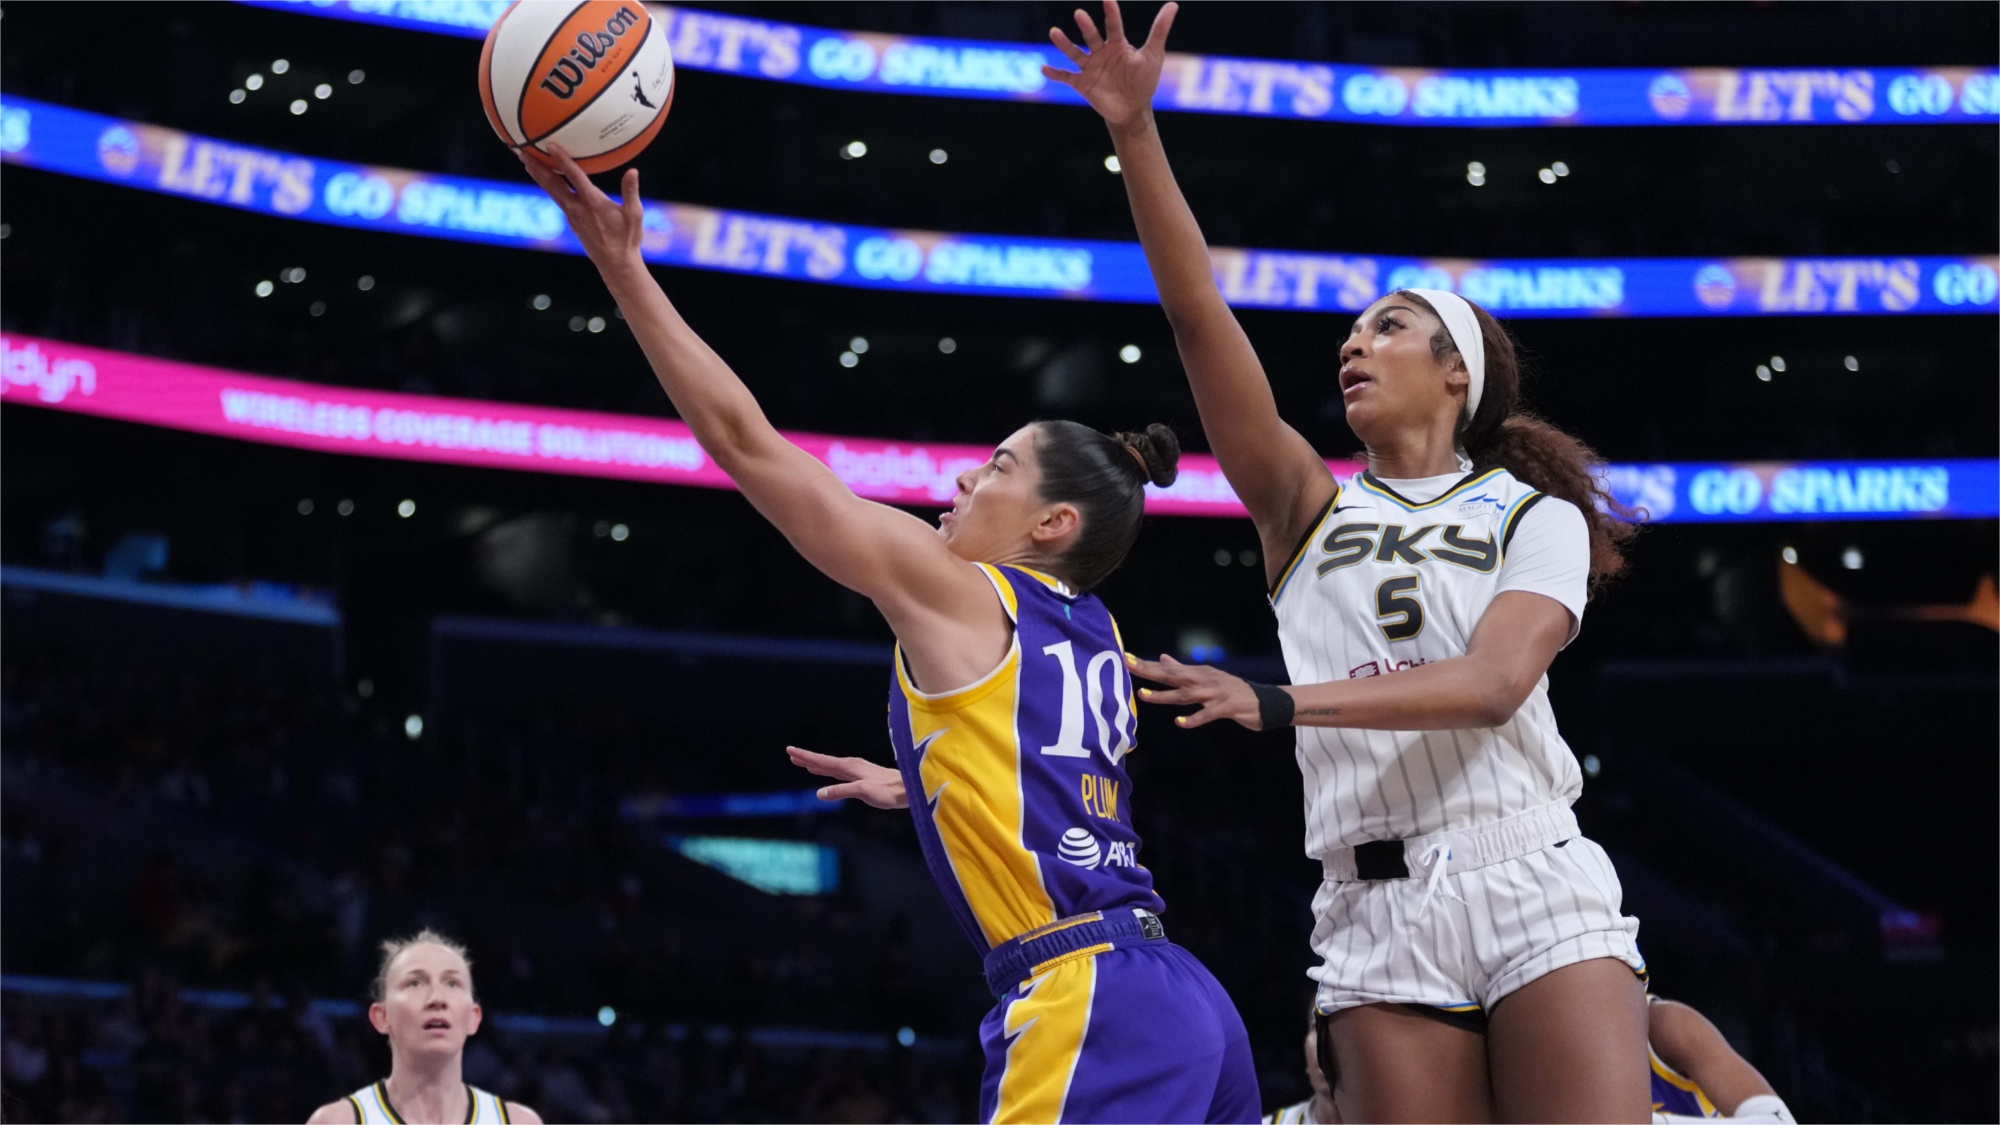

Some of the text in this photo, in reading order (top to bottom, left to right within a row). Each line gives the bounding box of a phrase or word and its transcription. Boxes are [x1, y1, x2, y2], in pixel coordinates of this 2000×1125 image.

[538, 5, 640, 101] Wilson
[808, 37, 877, 82] GO
[879, 43, 1047, 93] SPARKS
[1174, 55, 1580, 118] LET'S GO SPARKS
[1715, 71, 1875, 121] LET'S
[1887, 74, 1953, 115] GO
[158, 134, 566, 241] LET'S GO SPARKS
[692, 210, 1093, 291] LET'S GO SPARKS
[1222, 250, 1378, 311] LET'S
[1457, 266, 1624, 309] SPARKS
[1760, 258, 1998, 312] LET'S GO
[220, 387, 705, 472] WIRELESS COVERAGE SOLUTIONS
[1690, 469, 1762, 515] GO
[1768, 466, 1949, 514] SPARKS
[1315, 522, 1499, 580] SKY
[1375, 573, 1425, 642] 5
[1039, 640, 1132, 767] 10
[1081, 773, 1121, 823] PLUM
